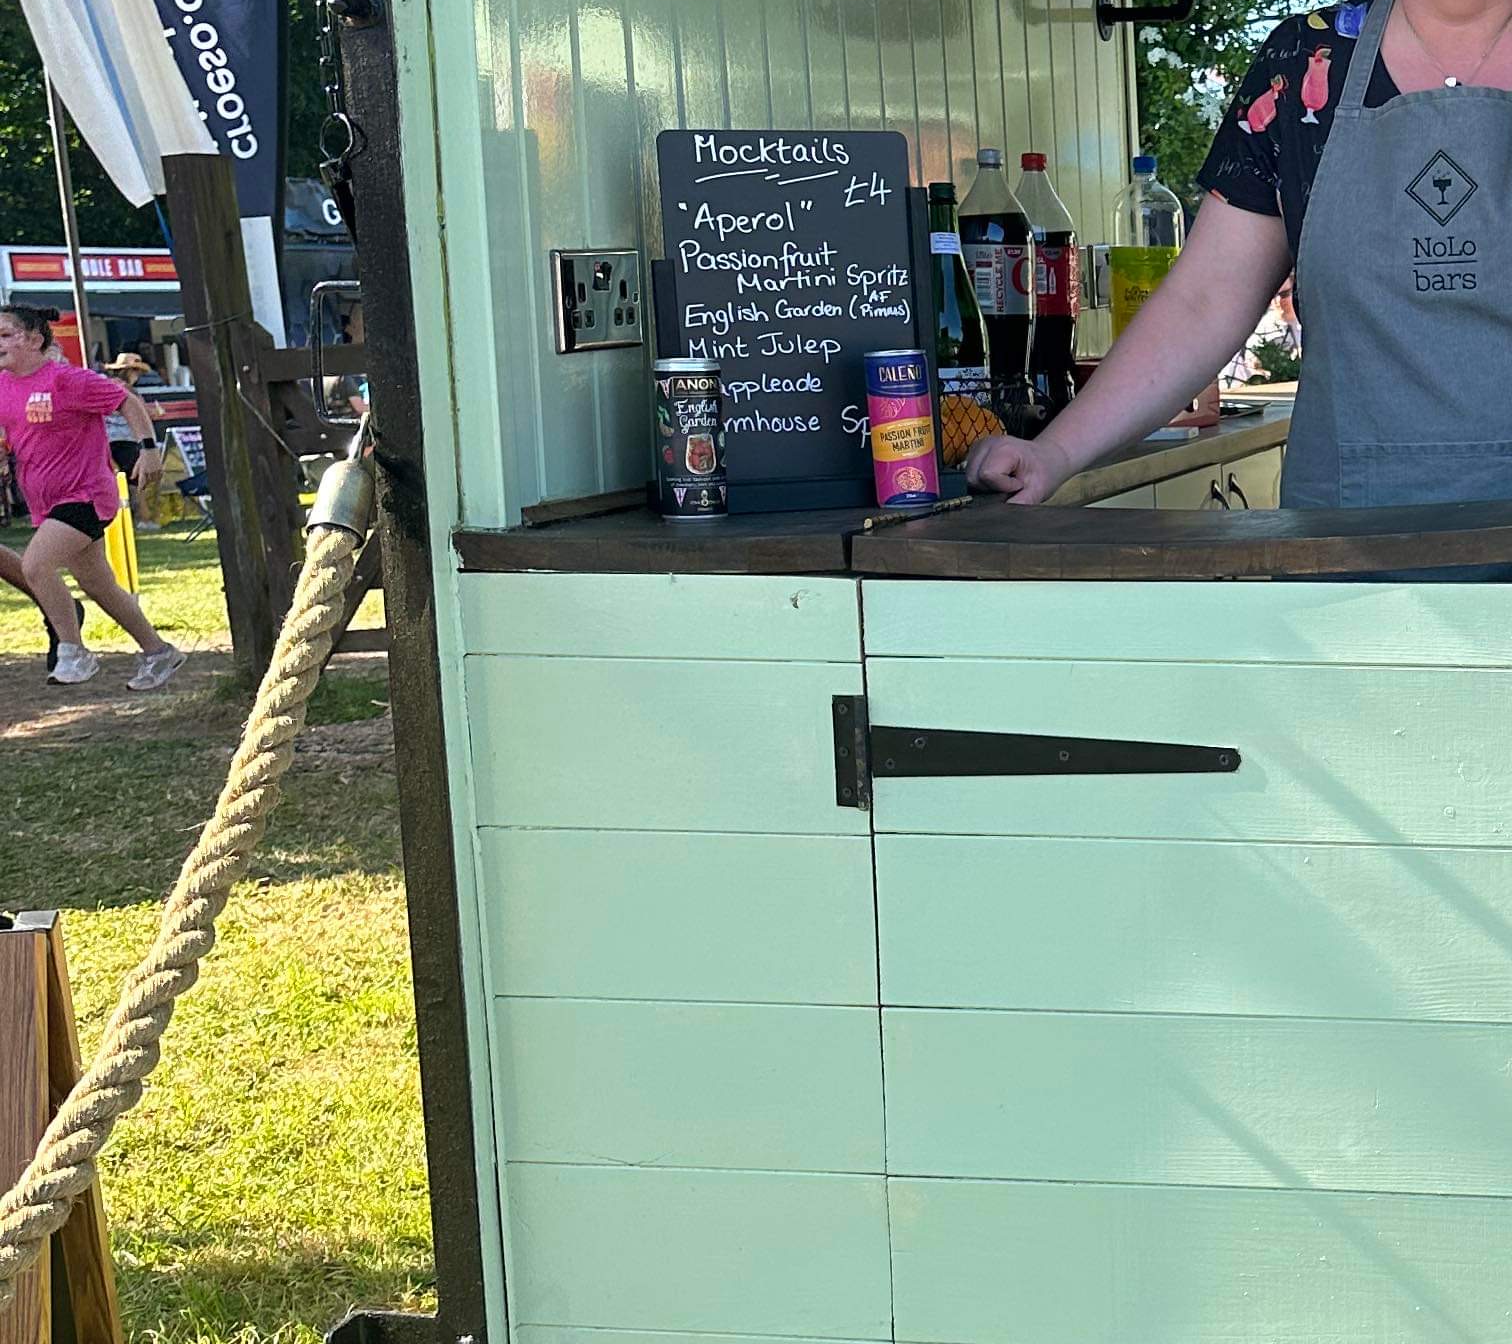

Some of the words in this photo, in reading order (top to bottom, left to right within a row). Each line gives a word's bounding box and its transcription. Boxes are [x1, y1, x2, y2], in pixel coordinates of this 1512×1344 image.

[694, 134, 850, 165] Mocktails
[844, 171, 893, 207] £4
[678, 239, 839, 278] Passionfruit
[1412, 236, 1477, 258] NoLo
[736, 267, 837, 294] Martini
[846, 263, 909, 296] Spritz
[1412, 269, 1477, 292] bars
[684, 301, 770, 336] English
[775, 299, 842, 319] Garden
[688, 337, 750, 359] Mint
[757, 331, 842, 364] Julep
[673, 398, 719, 417] English
[723, 409, 822, 434] rmhouse
[679, 414, 718, 434] Garden
[880, 428, 912, 443] PASSION
